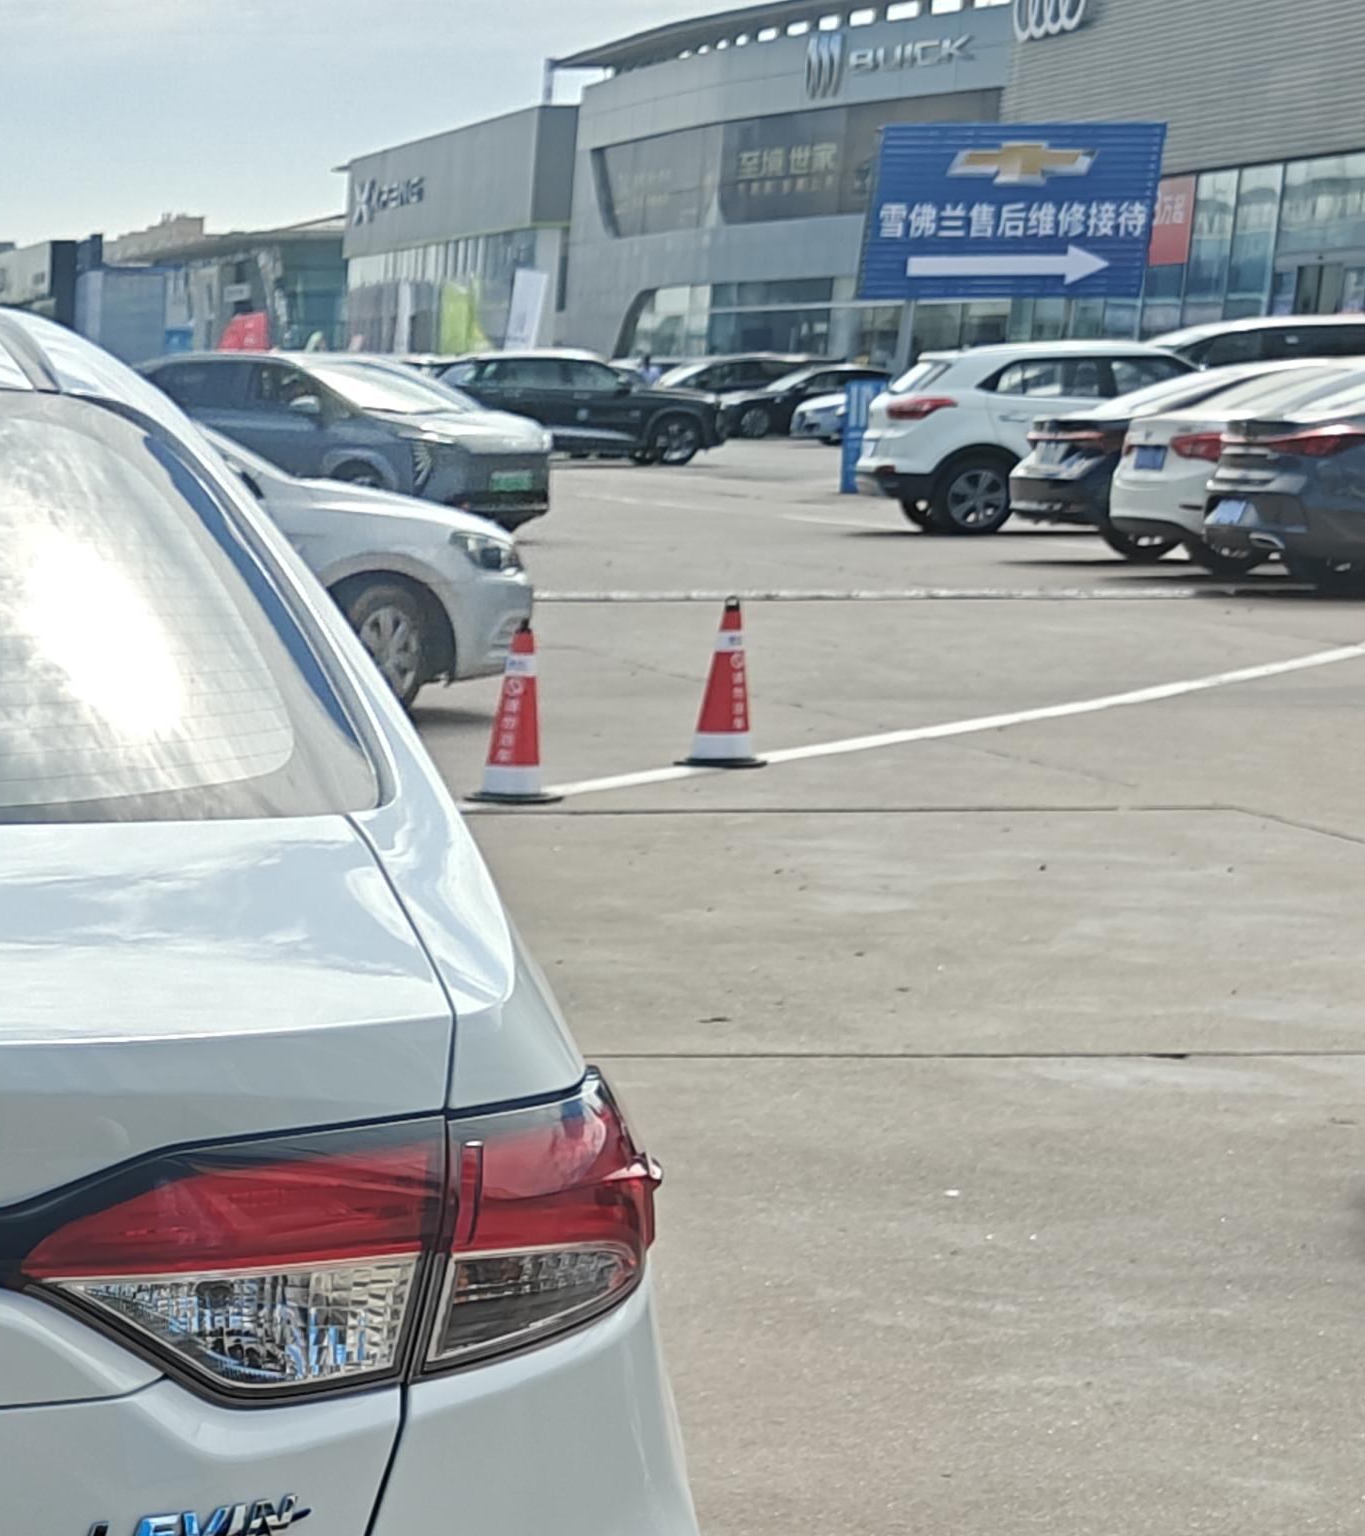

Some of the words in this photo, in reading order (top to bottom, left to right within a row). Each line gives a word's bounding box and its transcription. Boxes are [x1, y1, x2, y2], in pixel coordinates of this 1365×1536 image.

[849, 34, 975, 73] BUICK
[878, 201, 1147, 238] 雪佛兰售后维修接待
